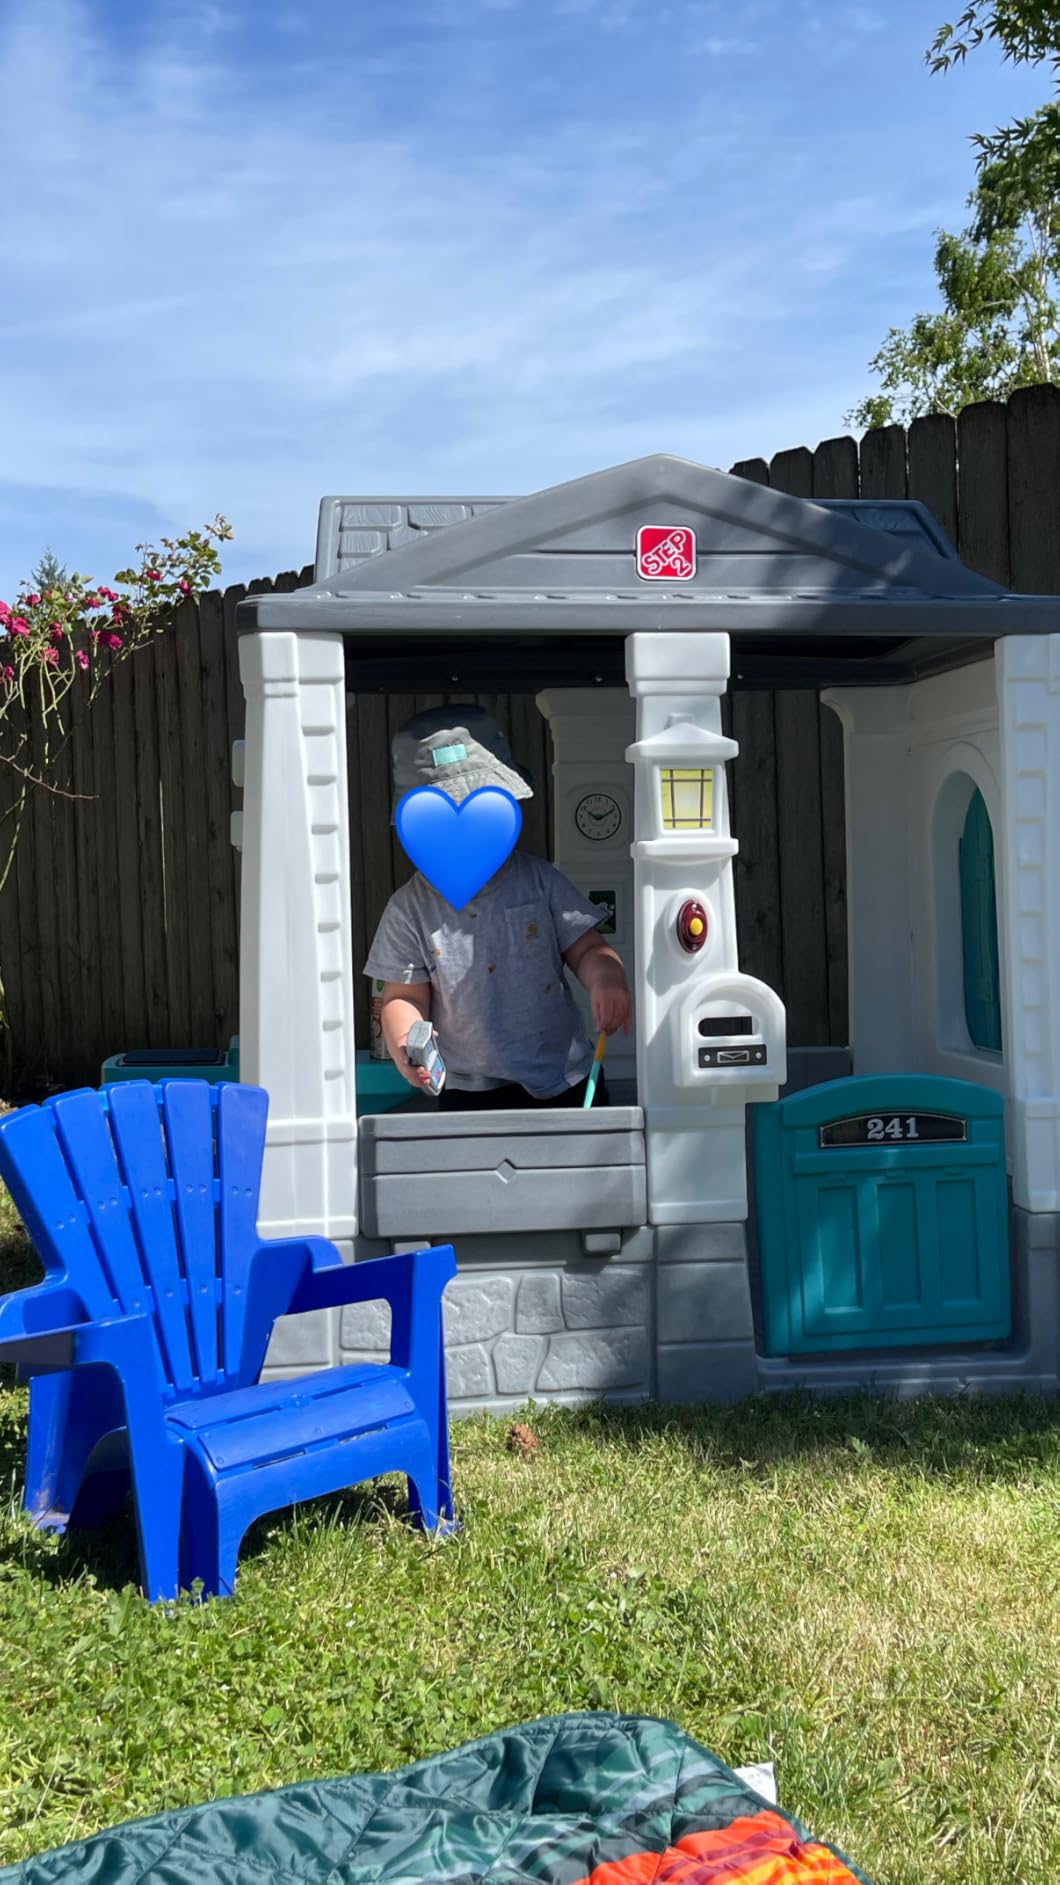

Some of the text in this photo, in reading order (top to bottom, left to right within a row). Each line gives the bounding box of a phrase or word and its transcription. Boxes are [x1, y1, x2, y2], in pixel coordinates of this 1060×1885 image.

[642, 530, 686, 574] STEP
[670, 554, 691, 576] 2
[867, 1117, 919, 1140] 241
